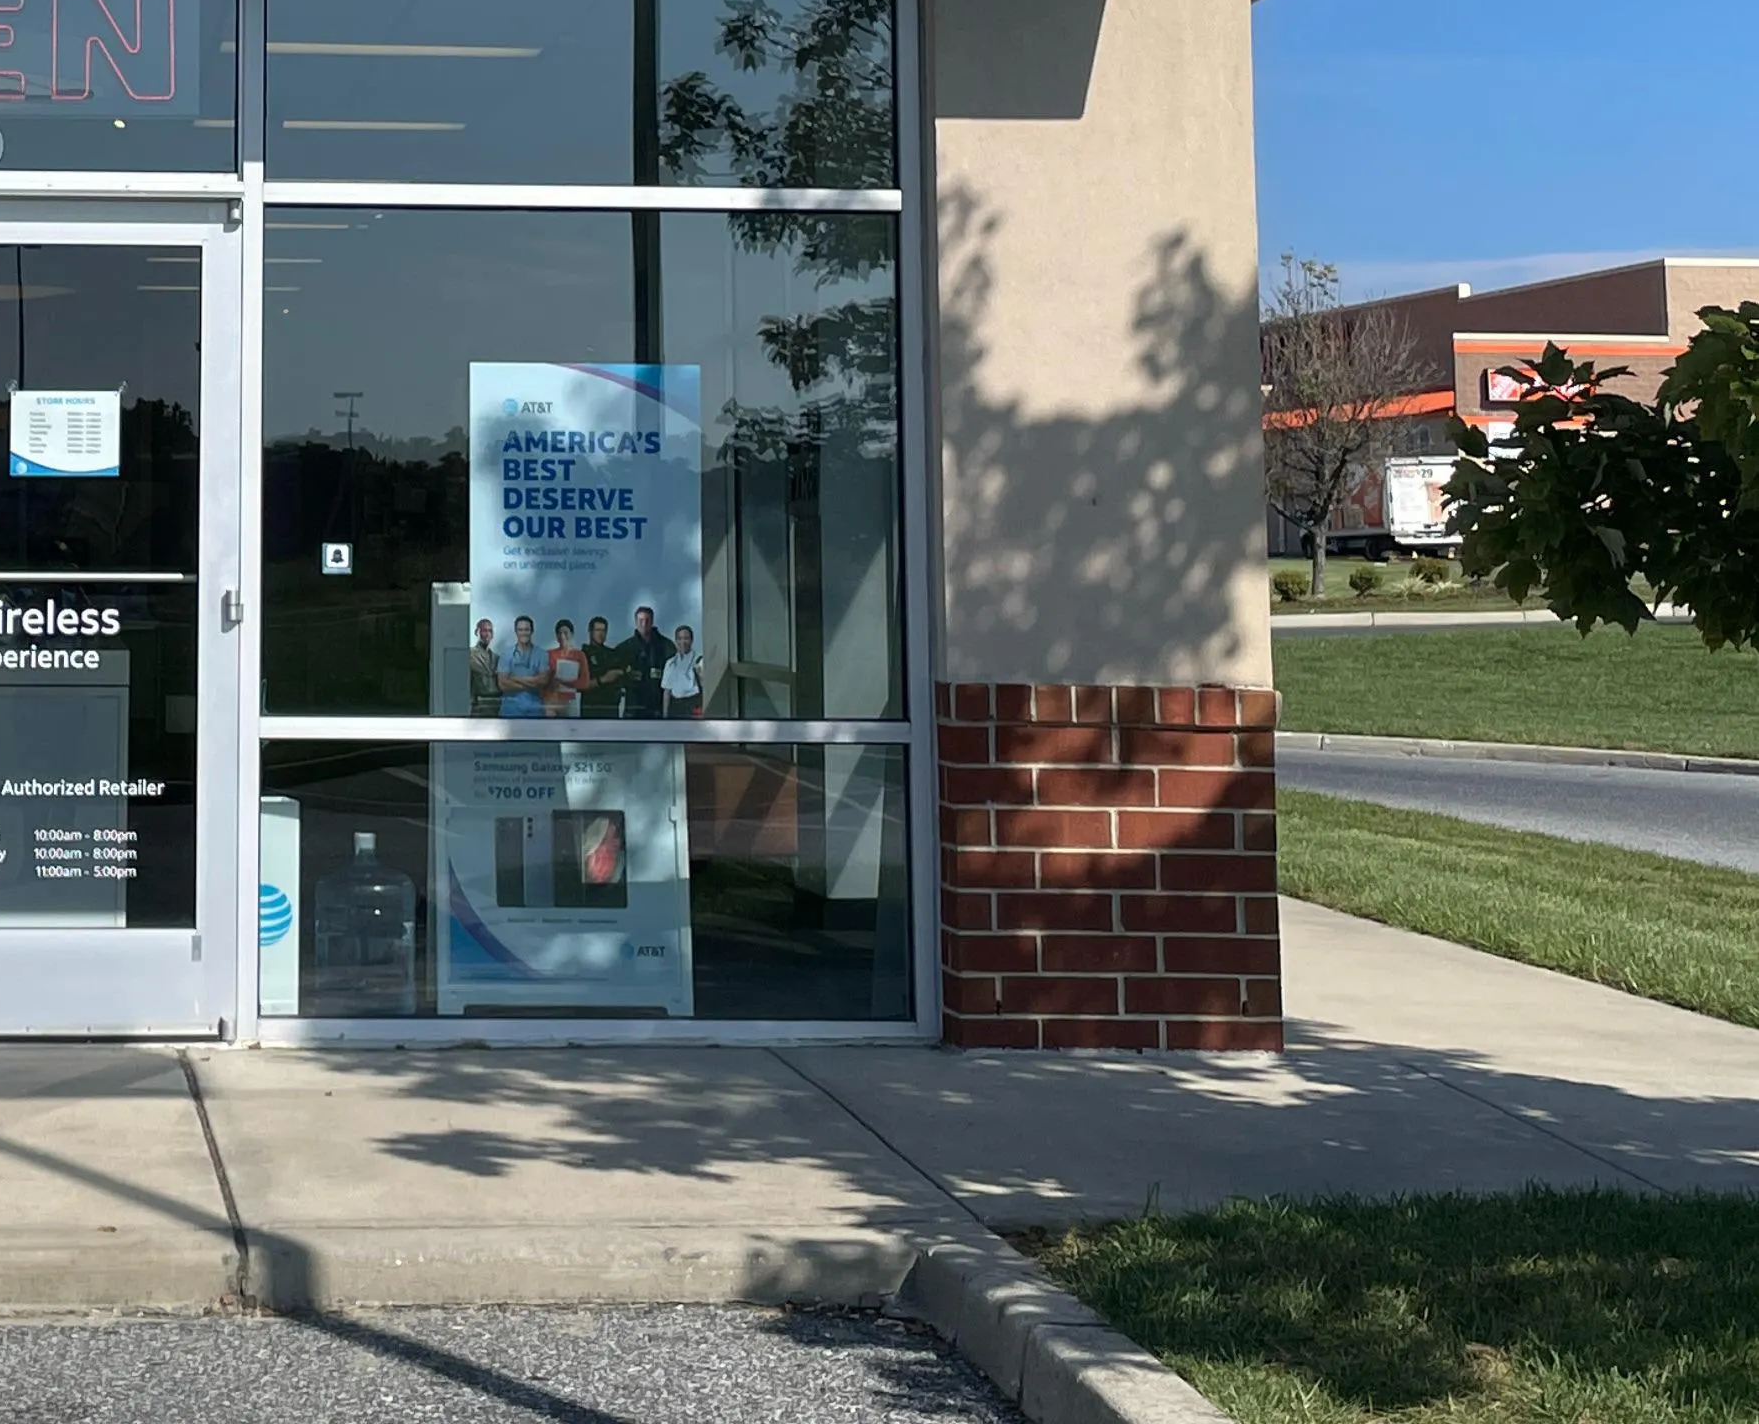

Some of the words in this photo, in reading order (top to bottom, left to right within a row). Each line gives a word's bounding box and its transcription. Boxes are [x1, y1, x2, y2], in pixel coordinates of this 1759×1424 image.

[521, 401, 554, 414] AT&T
[503, 430, 662, 455] AMERICA'S
[503, 458, 577, 482] BEST
[503, 487, 635, 511] DESERVE
[503, 515, 567, 540] OUR
[575, 516, 649, 540] BEST
[473, 761, 528, 775] Samsung
[531, 761, 571, 775] Galaxy
[1, 778, 95, 797] Authorized
[99, 778, 166, 797] Retailer
[487, 786, 523, 800] $700
[526, 786, 556, 799] OFF
[33, 829, 83, 843] 10:00am
[92, 829, 138, 844] 8:00pm
[33, 848, 83, 861] 10:00am
[92, 847, 138, 863] 8:00pm
[34, 866, 83, 878] 11:00am
[92, 866, 138, 881] 5:00pm
[636, 945, 666, 958] AT&T
